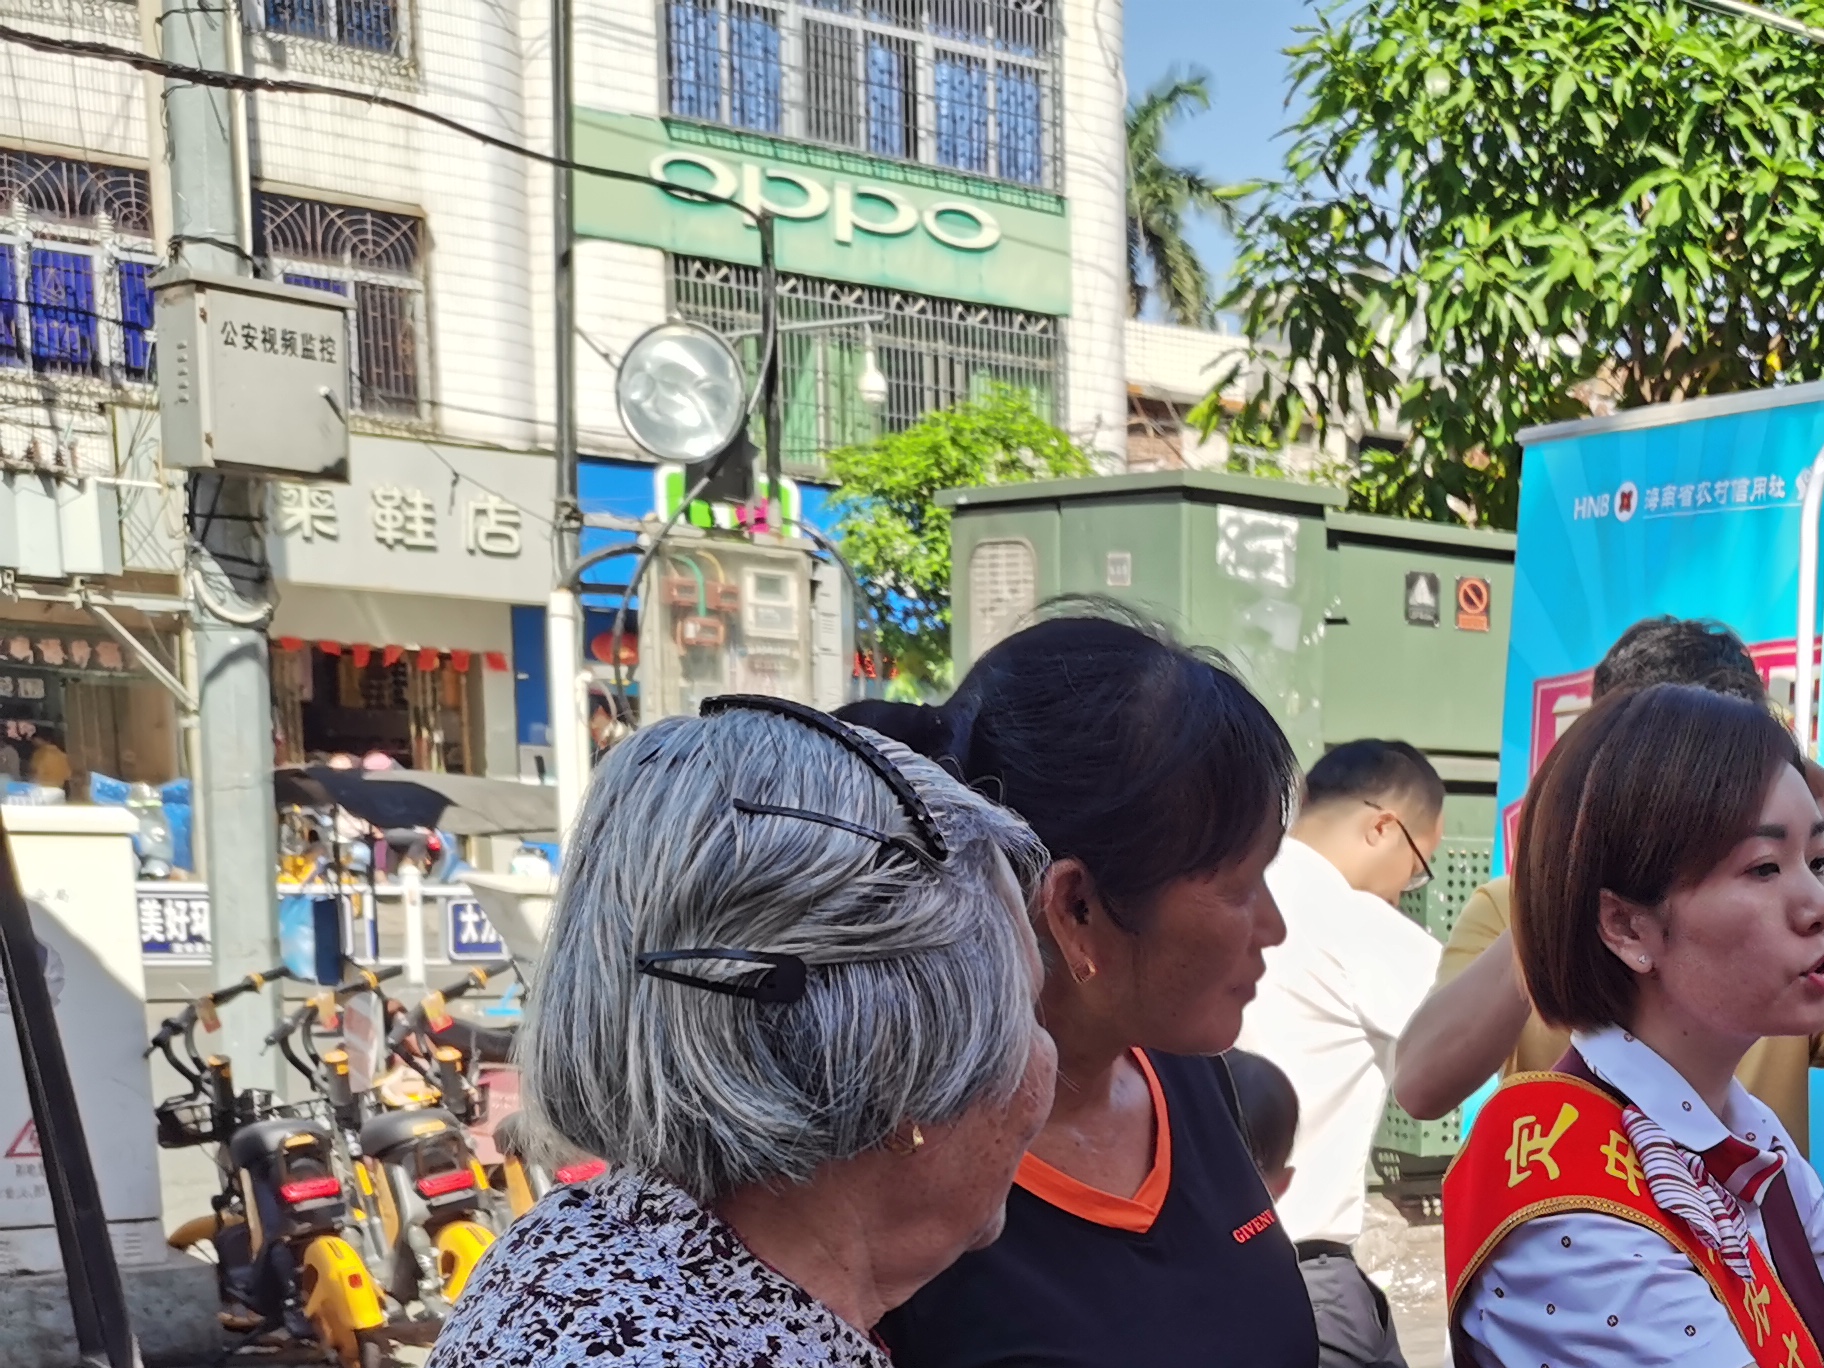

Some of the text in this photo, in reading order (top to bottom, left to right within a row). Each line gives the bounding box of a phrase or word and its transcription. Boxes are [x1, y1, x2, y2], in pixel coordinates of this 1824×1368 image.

[221, 320, 337, 364] 公安视频监控
[1574, 494, 1610, 520] HNB
[1644, 474, 1786, 511] 海南省农村信用社
